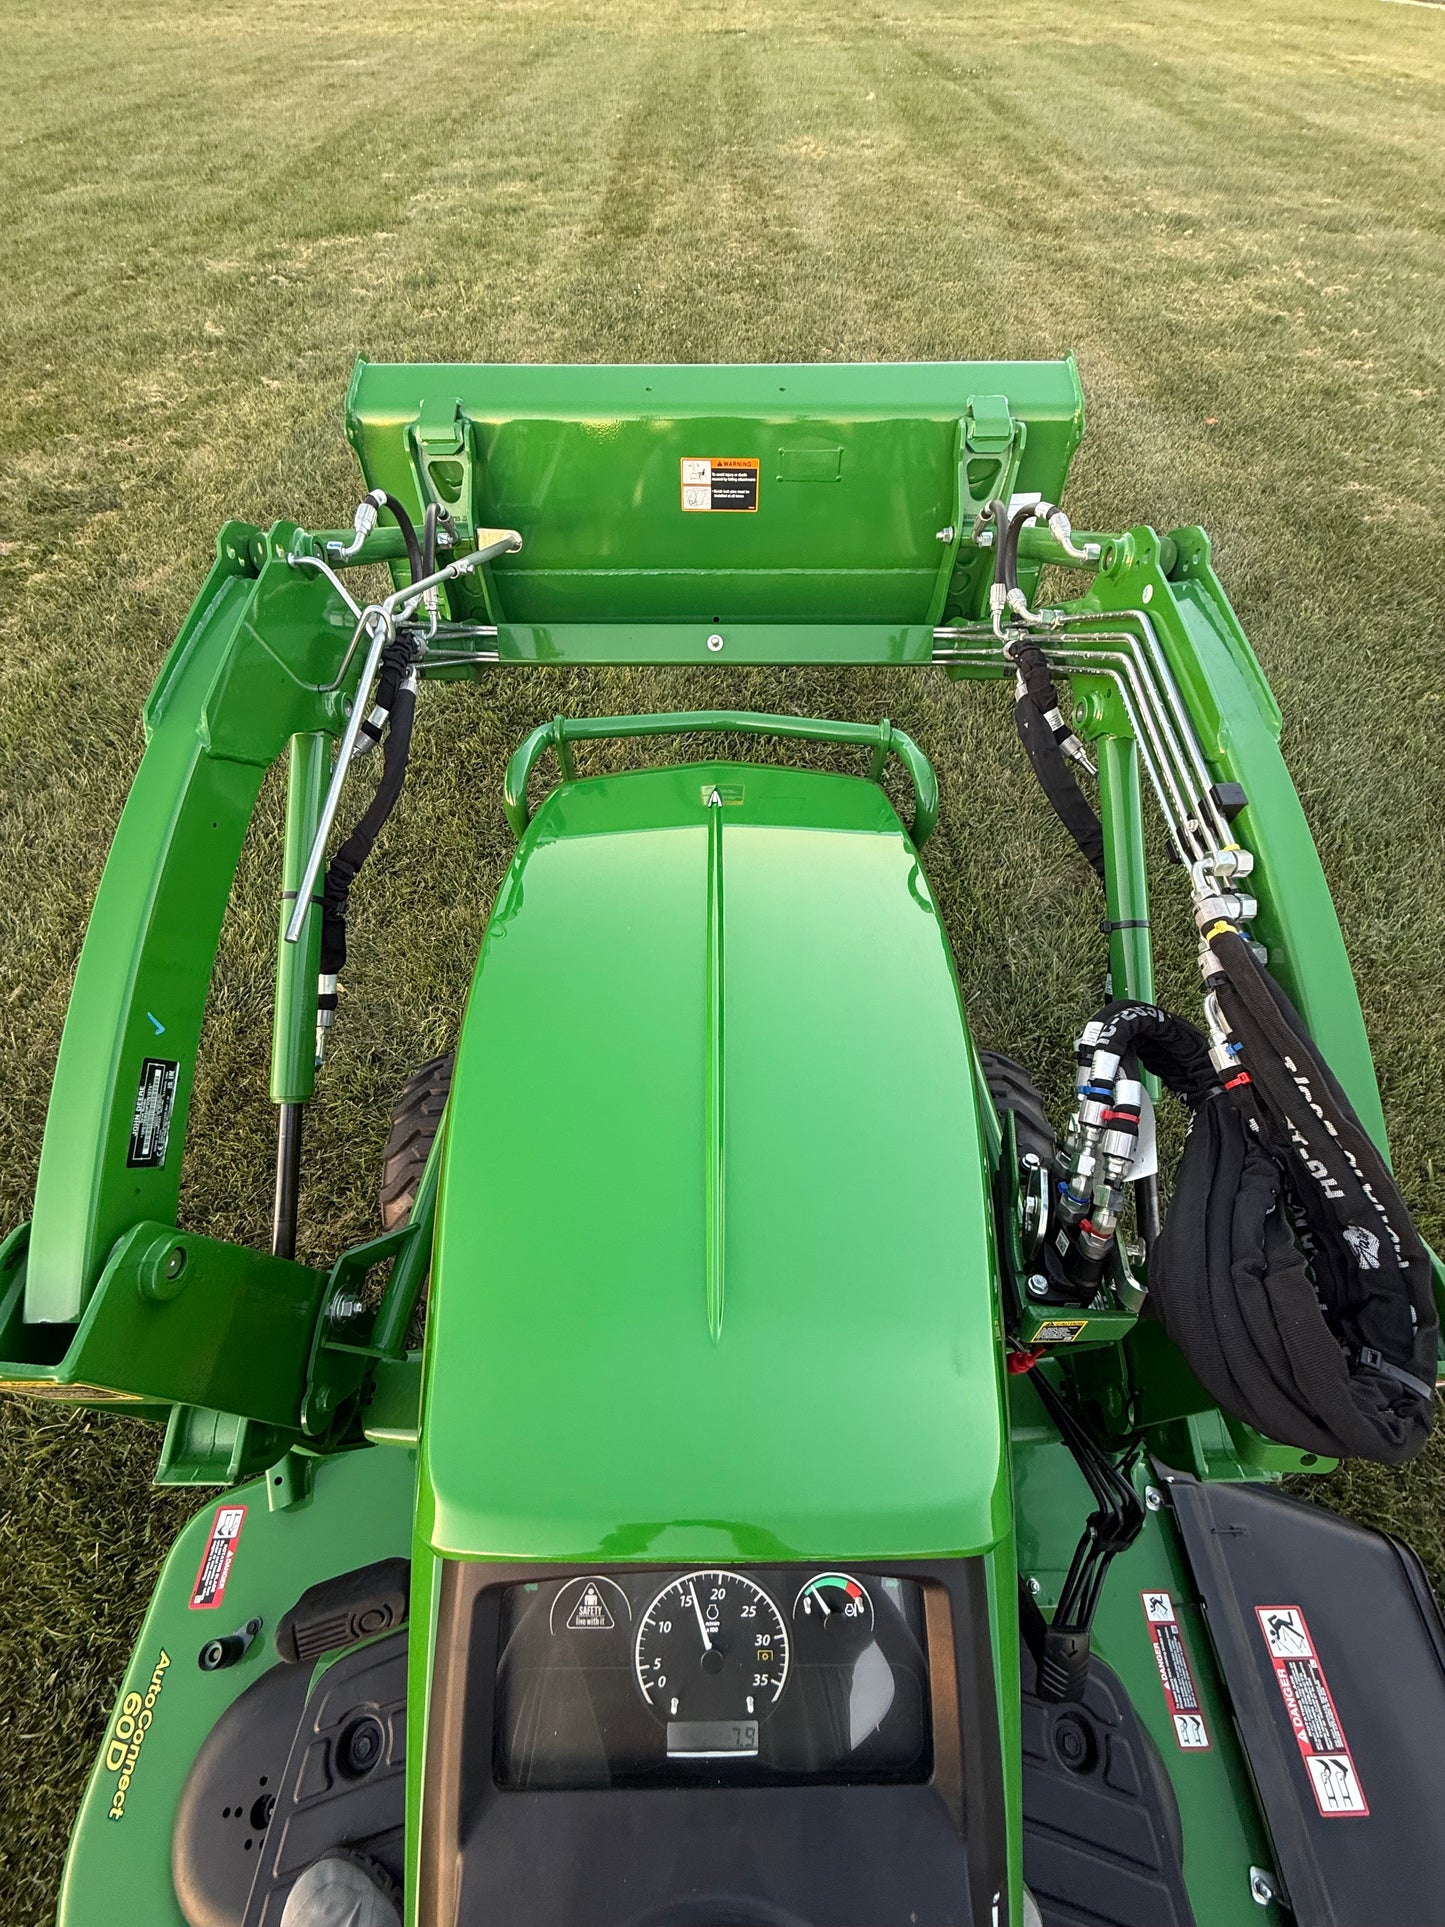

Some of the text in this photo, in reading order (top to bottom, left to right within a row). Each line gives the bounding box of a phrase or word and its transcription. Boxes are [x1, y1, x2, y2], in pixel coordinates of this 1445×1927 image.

[132, 1085, 145, 1136] JOHN DEERE
[218, 1558, 231, 1589] DANGER
[710, 1588, 726, 1600] 20
[680, 1595, 693, 1607] 15
[579, 1605, 603, 1616] SAFETY
[741, 1606, 757, 1617] 25
[576, 1615, 586, 1625] live
[586, 1615, 600, 1625] with
[659, 1621, 672, 1633] 10
[754, 1634, 771, 1646] 30
[653, 1658, 661, 1670] 5
[1153, 1642, 1168, 1680] DANGER
[658, 1676, 666, 1687] 0
[752, 1674, 768, 1686] 35
[1277, 1668, 1303, 1727] DANGER
[106, 1691, 142, 1771] 60D
[108, 1648, 171, 1821] AutoConnect
